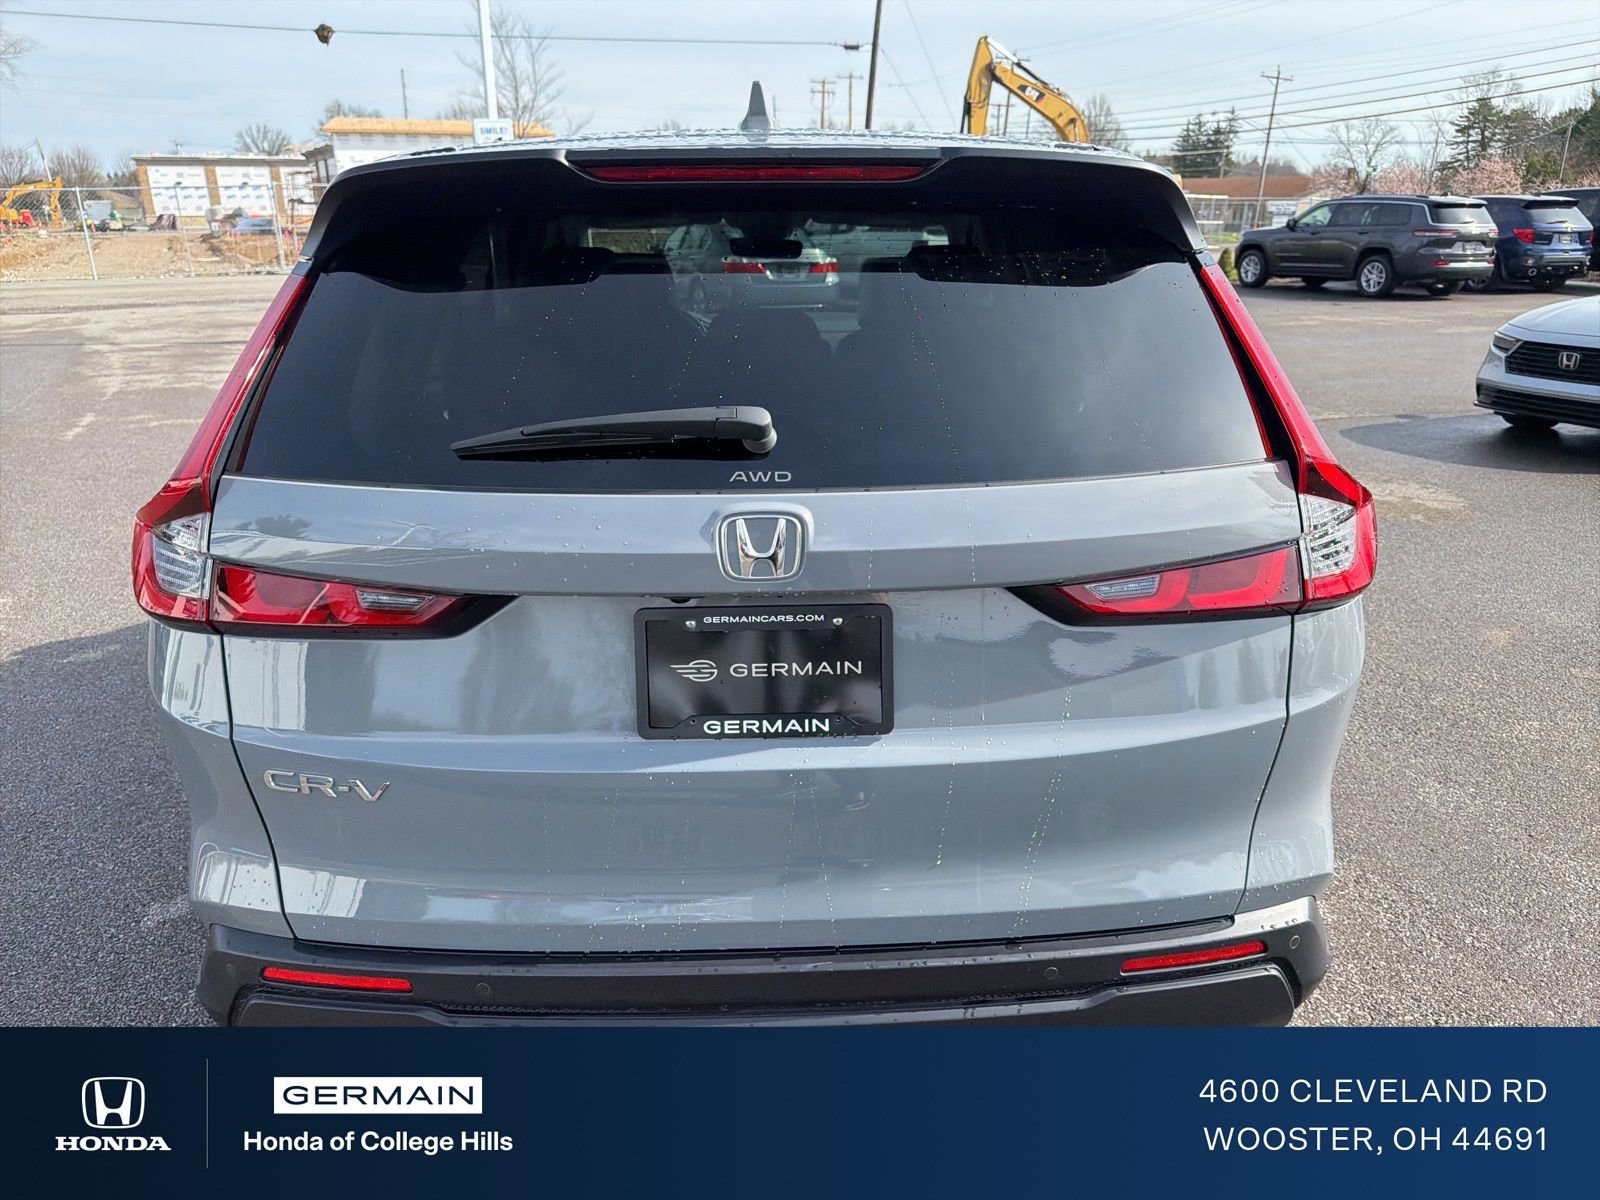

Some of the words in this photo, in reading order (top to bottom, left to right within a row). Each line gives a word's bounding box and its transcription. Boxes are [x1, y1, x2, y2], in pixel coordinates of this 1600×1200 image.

[729, 471, 792, 483] AWD
[703, 614, 825, 624] GERMAINCARS.COM
[729, 660, 862, 678] GERMAIN
[702, 718, 830, 735] GERMAIN
[263, 768, 391, 801] CR-V
